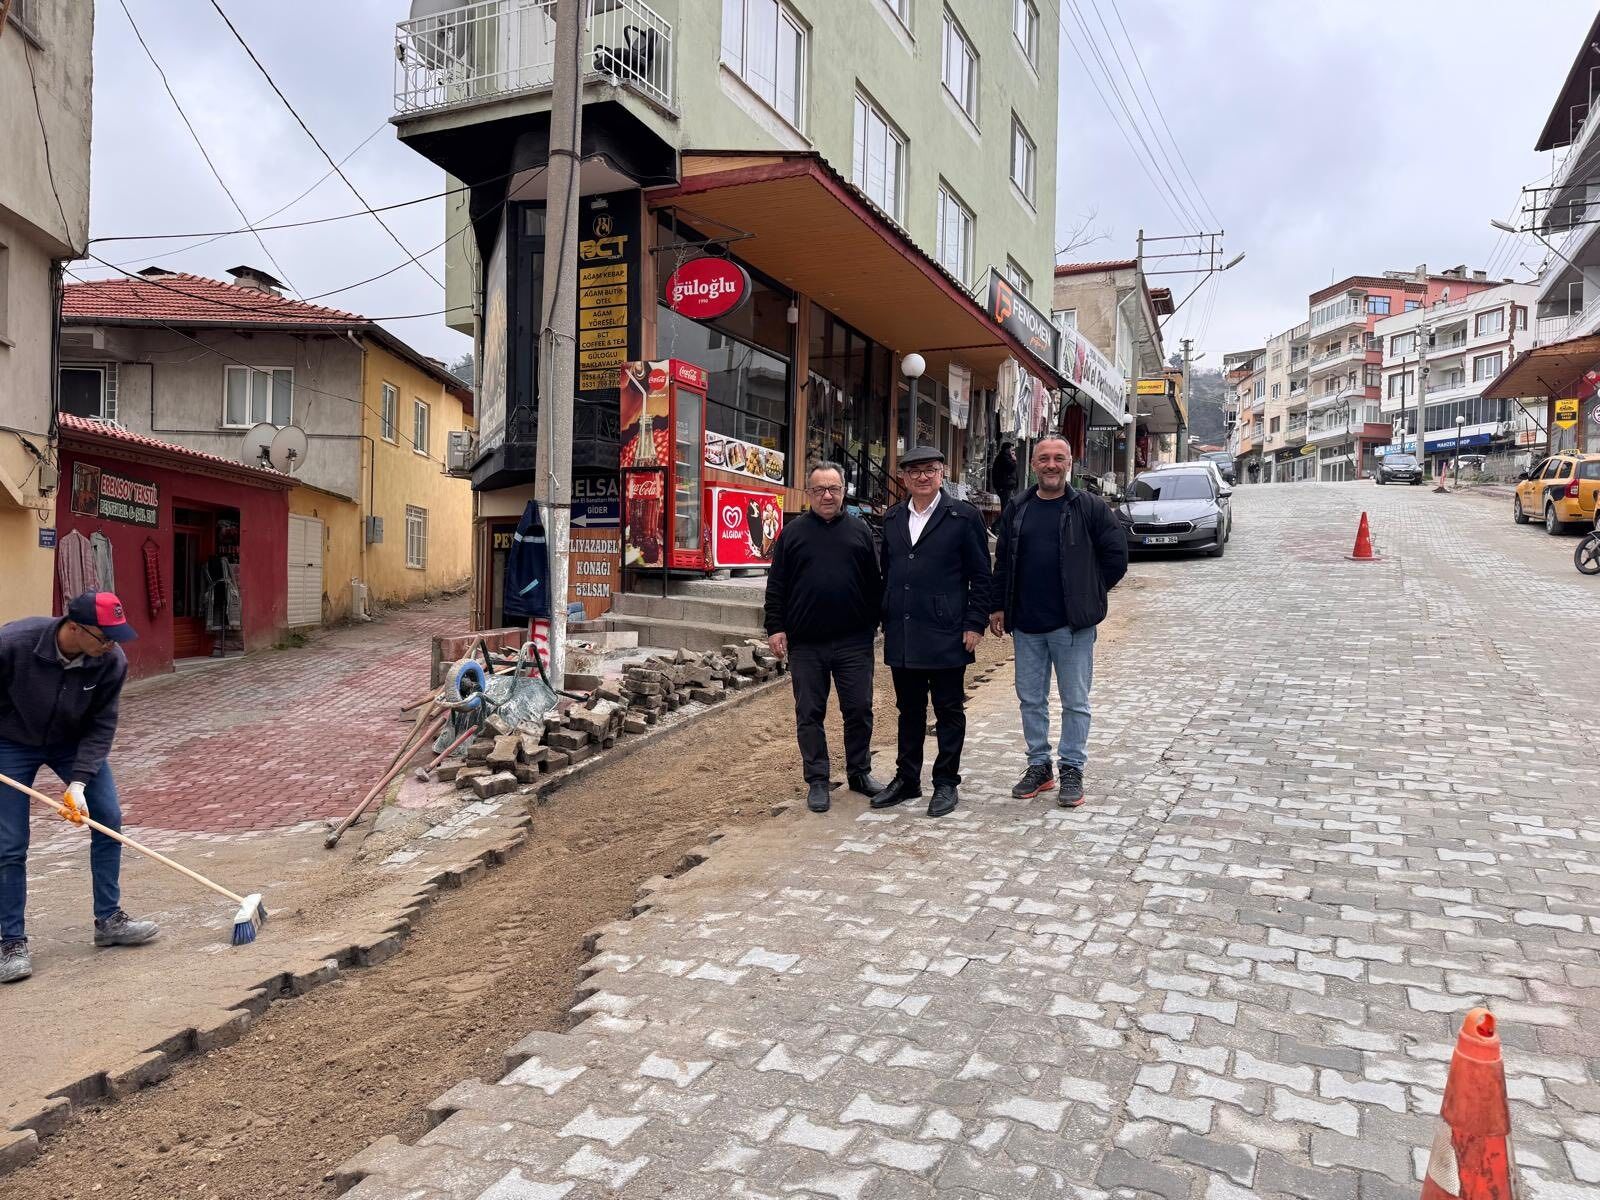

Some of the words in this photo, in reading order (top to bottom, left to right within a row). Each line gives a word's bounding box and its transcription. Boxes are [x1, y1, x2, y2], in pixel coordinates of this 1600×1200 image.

[580, 235, 628, 258] BCT
[603, 270, 625, 279] KEBAP
[673, 277, 736, 301] güloğlu
[593, 309, 612, 317] AĞAM
[588, 319, 616, 327] YÖRESEL
[1013, 299, 1051, 347] FENOMEN
[581, 341, 606, 349] COFFEE
[588, 351, 618, 360] GÜLOĞLU
[134, 482, 158, 507] TEKSTİL
[571, 478, 619, 497] ELSA
[587, 504, 608, 514] GİDER
[722, 529, 742, 539] ALGIDA
[570, 536, 620, 554] LİYAZADEL
[576, 558, 611, 576] KONAĞI
[576, 582, 610, 598] BELSAM
